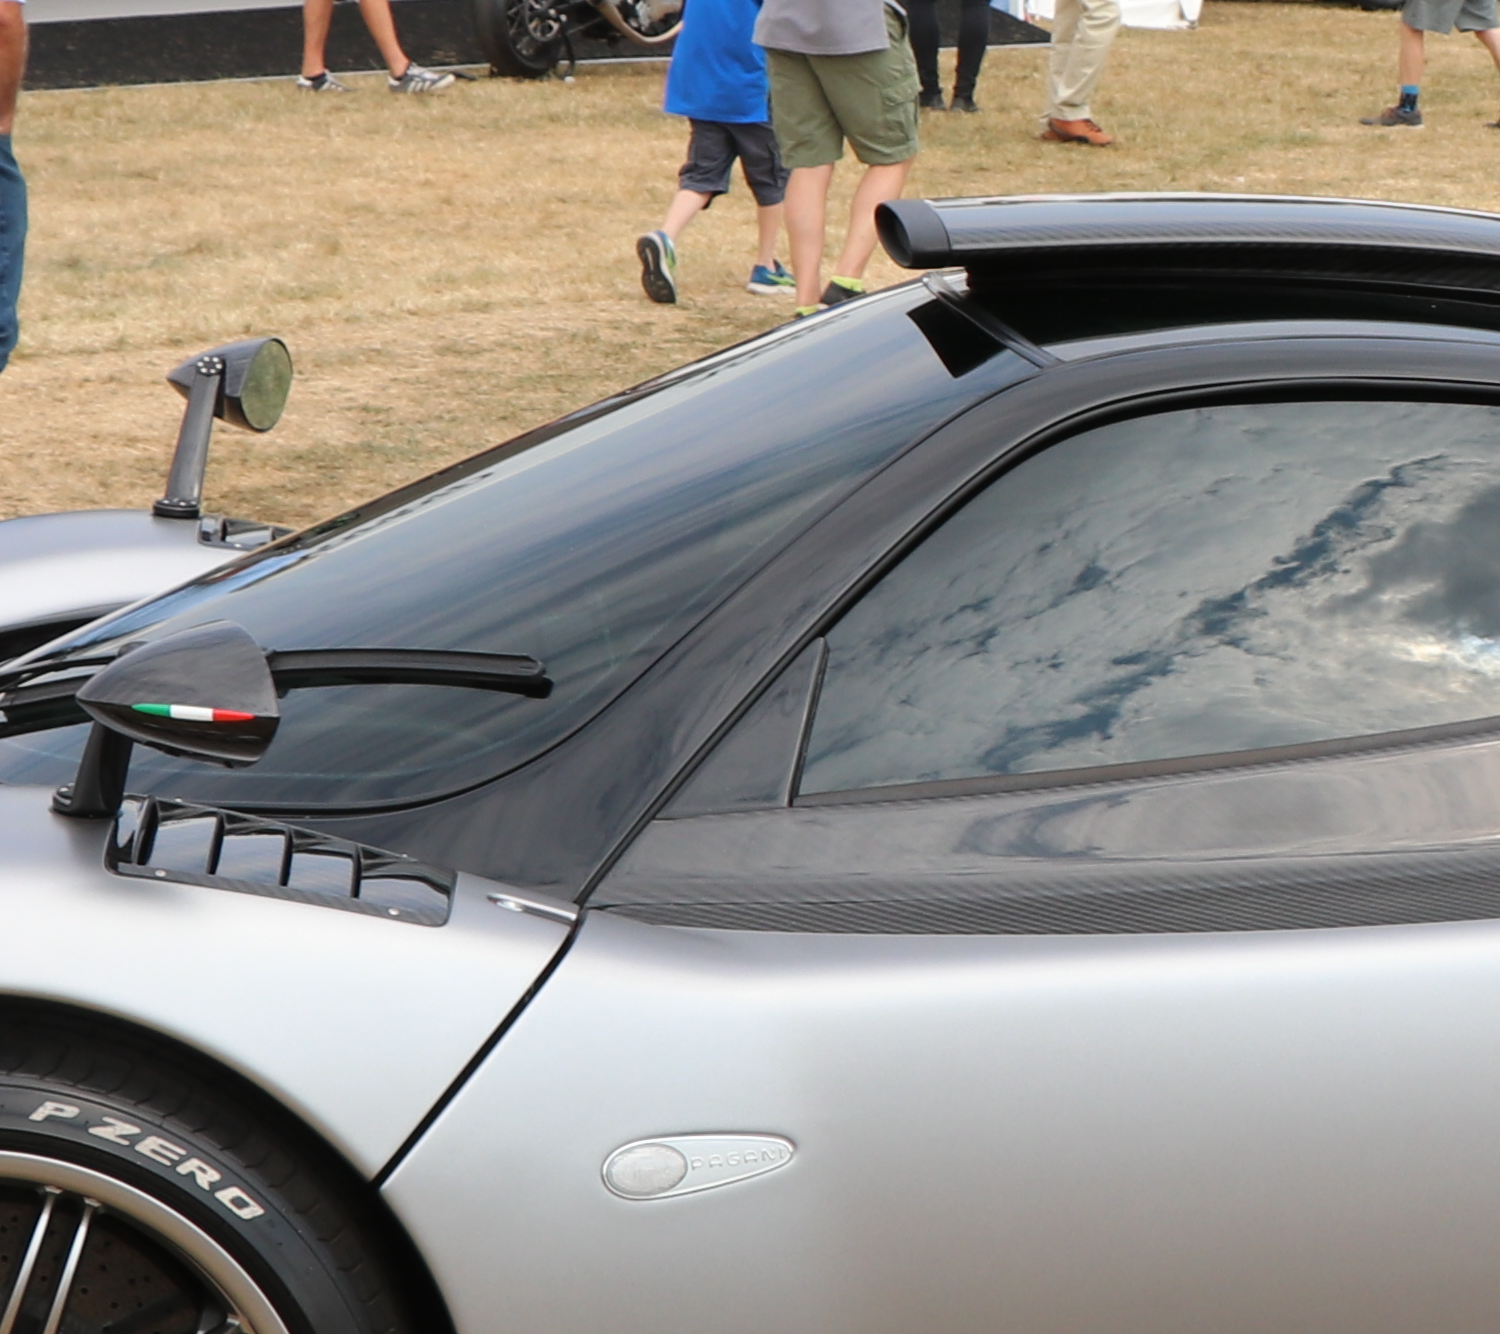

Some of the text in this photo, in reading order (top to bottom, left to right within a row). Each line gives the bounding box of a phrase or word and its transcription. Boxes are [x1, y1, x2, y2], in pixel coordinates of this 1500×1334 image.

[29, 1101, 265, 1220] P ZERO
[690, 1146, 787, 1171] PAGANI
